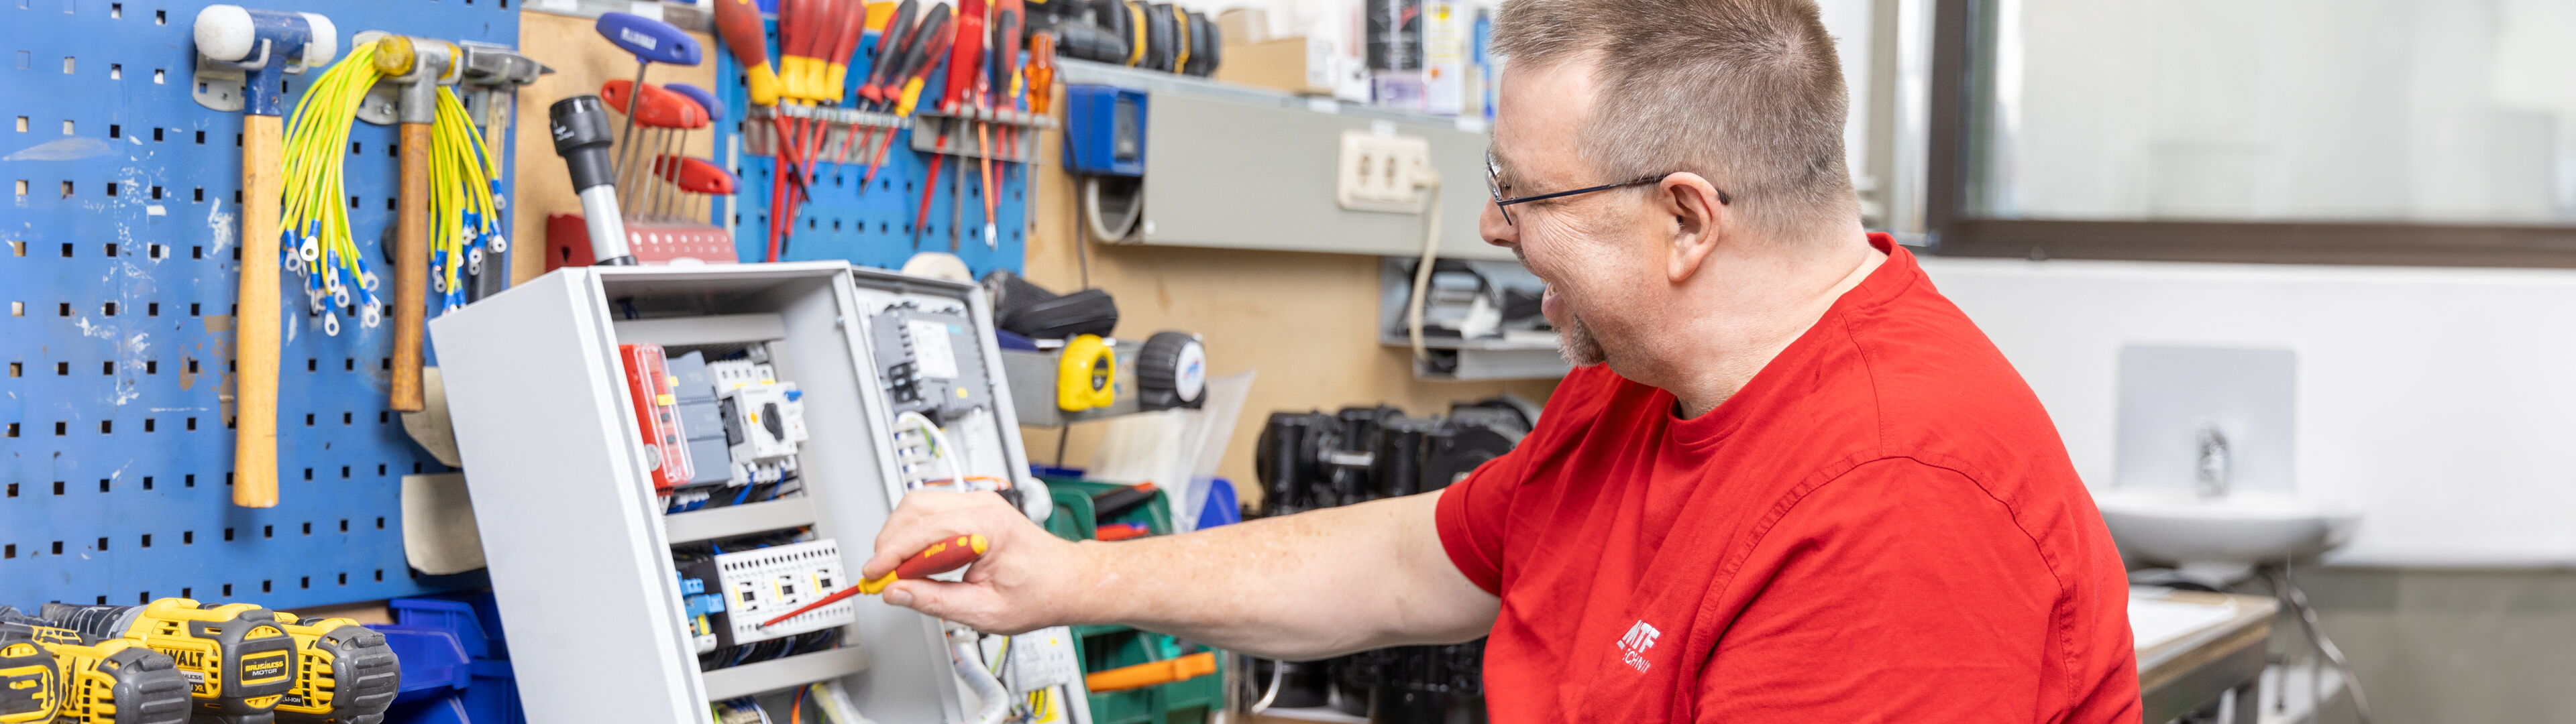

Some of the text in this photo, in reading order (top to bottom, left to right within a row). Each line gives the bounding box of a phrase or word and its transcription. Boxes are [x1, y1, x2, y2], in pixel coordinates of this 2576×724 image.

[163, 648, 205, 668] WALT
[245, 661, 284, 672] BRUSHLESS
[252, 668, 278, 676] MOTOR
